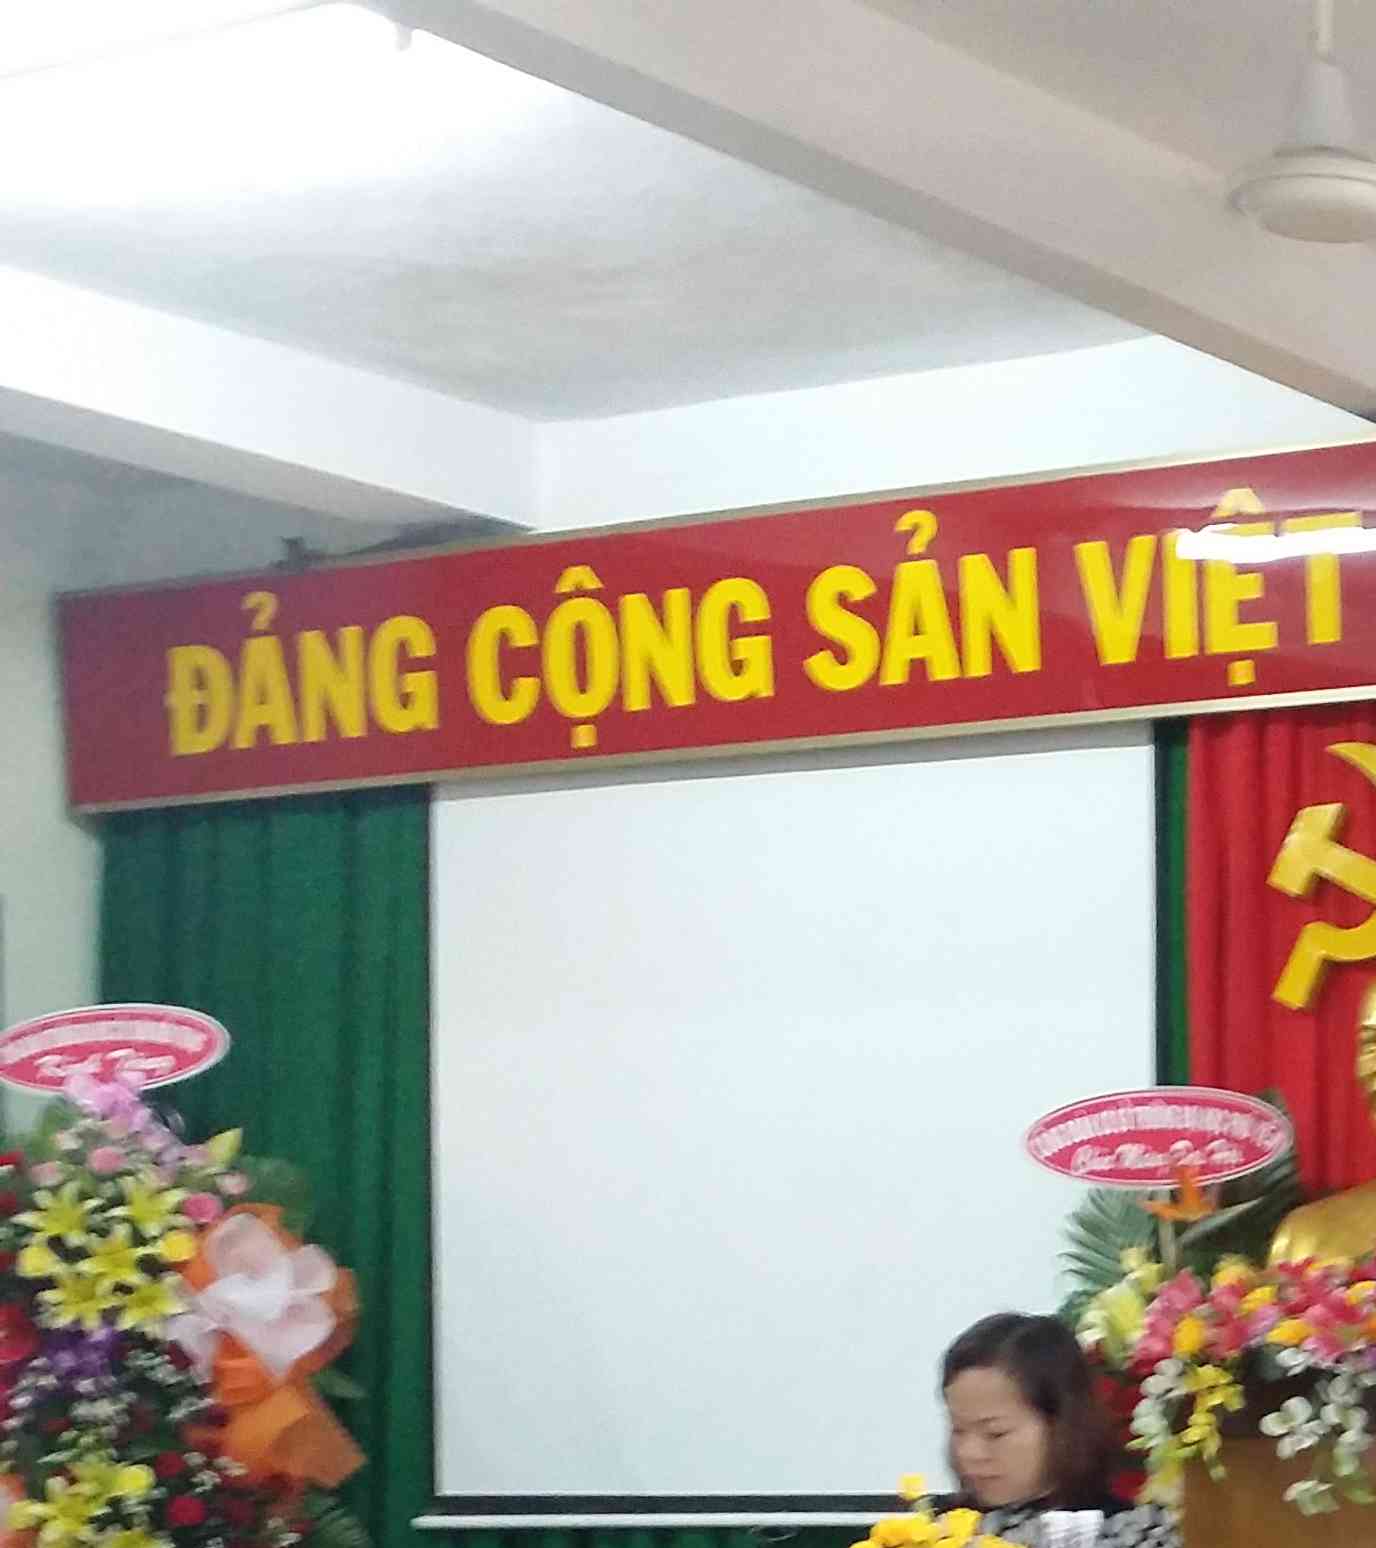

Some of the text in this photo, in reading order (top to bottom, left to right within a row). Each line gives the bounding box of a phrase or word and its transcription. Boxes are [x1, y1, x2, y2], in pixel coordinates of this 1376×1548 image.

[166, 591, 440, 757] ĐẢNG
[465, 564, 776, 750] CỘNG
[803, 509, 1043, 692] SẢN
[1073, 486, 1362, 687] VIỆT
